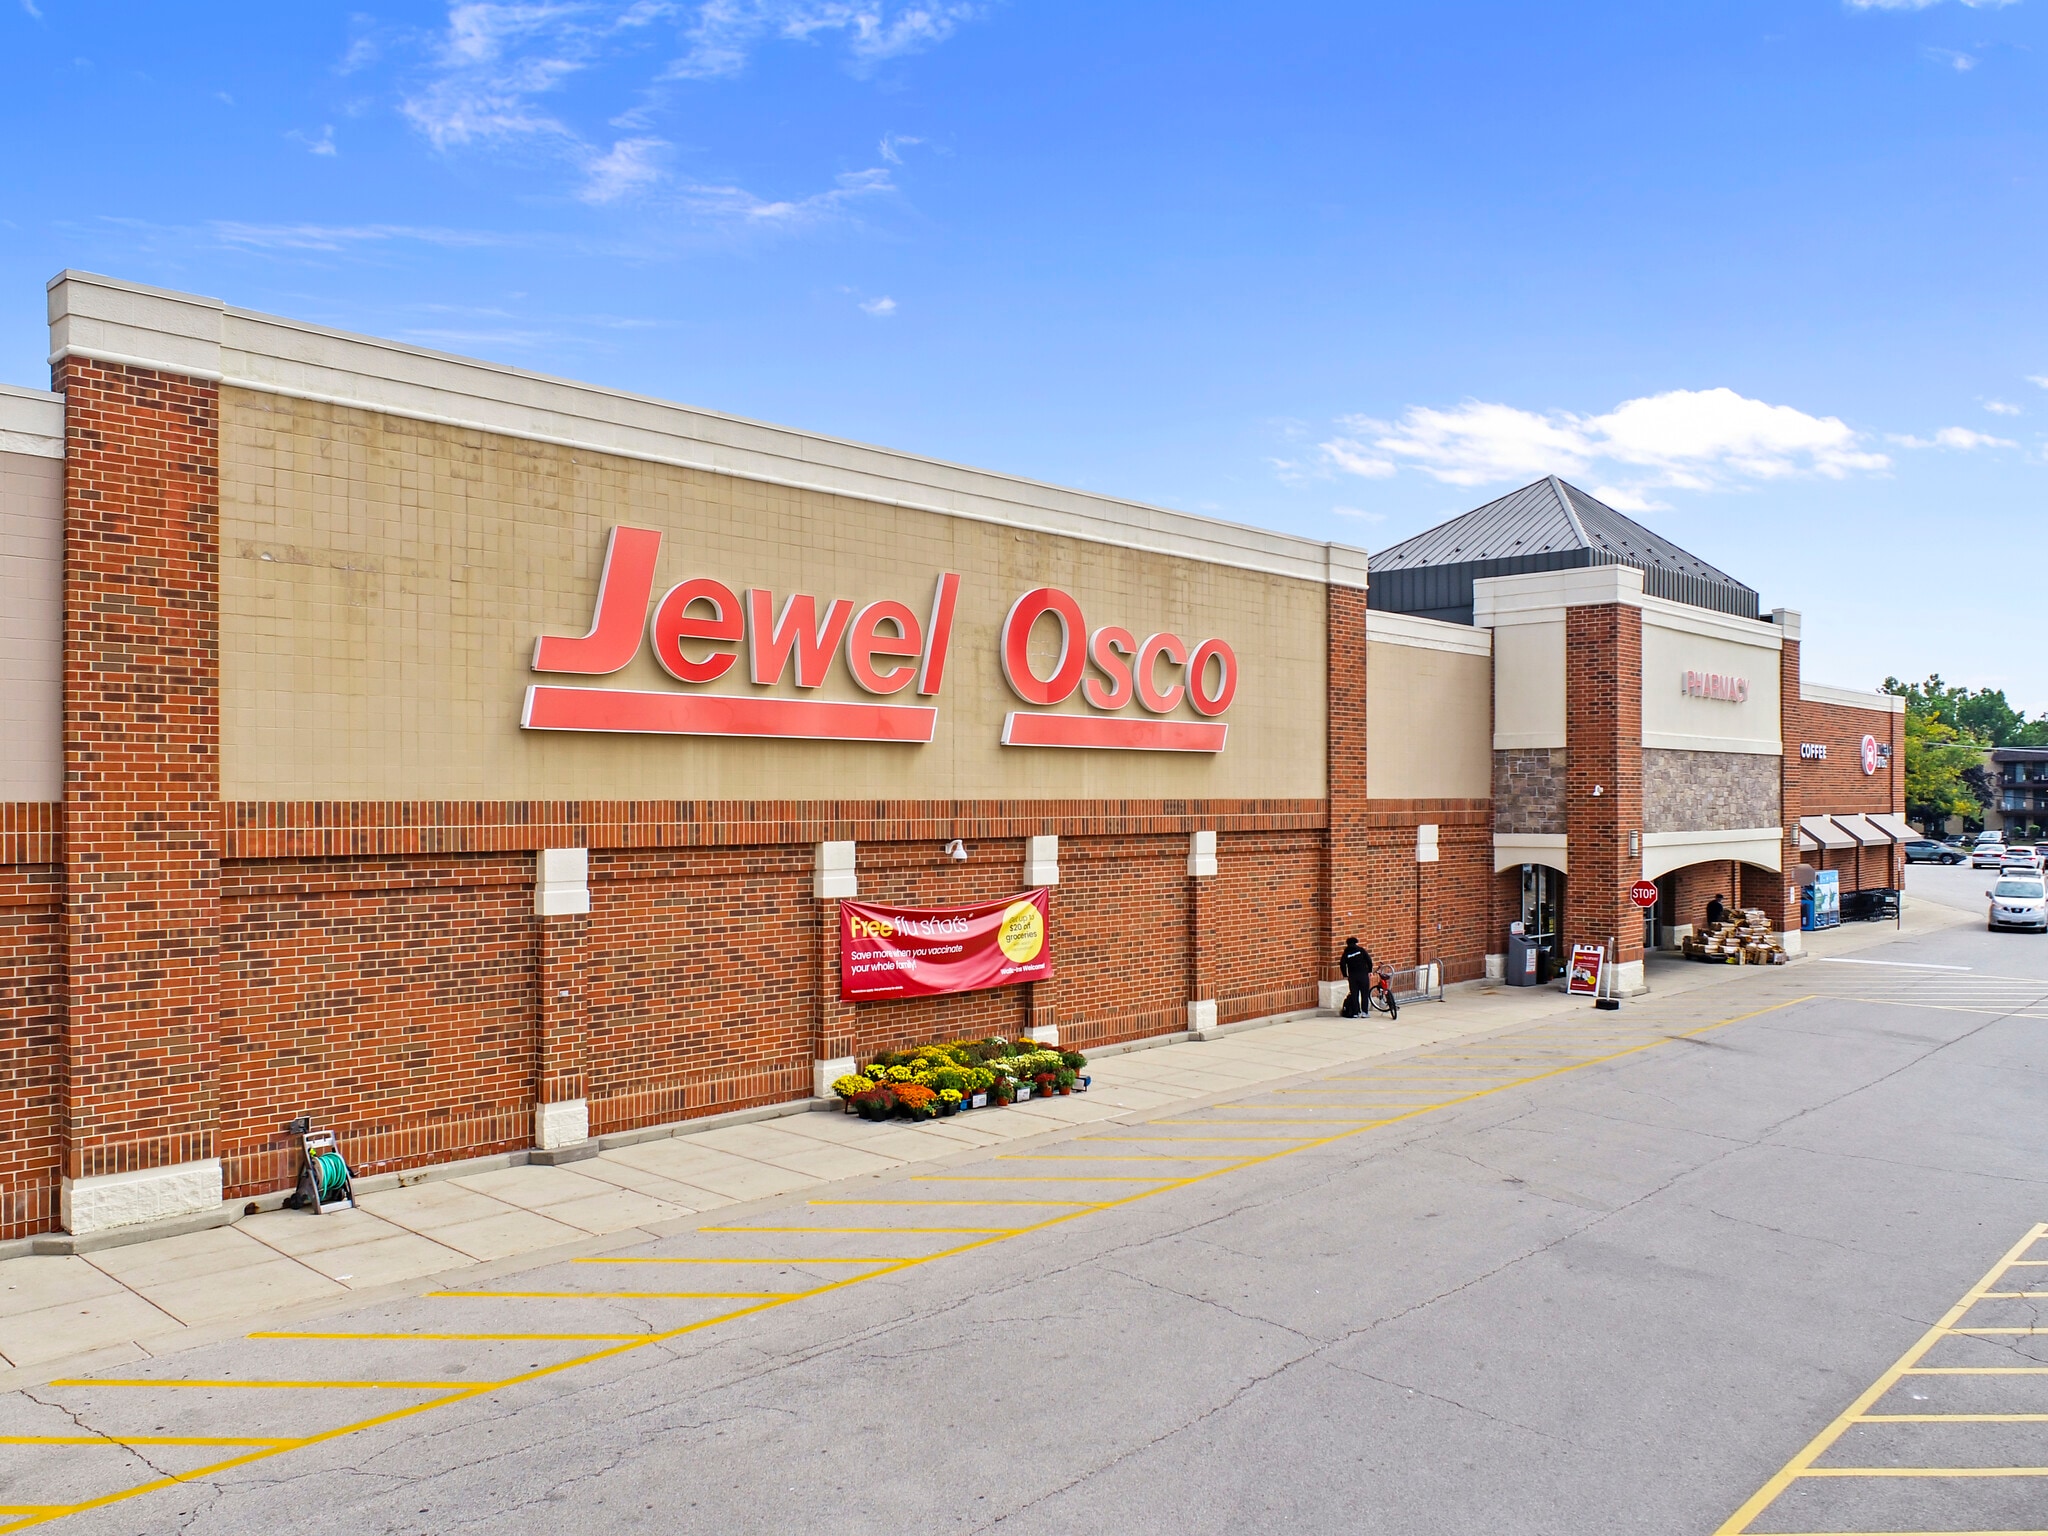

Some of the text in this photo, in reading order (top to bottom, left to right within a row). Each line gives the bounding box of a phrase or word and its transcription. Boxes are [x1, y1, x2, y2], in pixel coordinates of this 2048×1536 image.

[530, 525, 1239, 717] Jewel Osco
[1681, 671, 1750, 703] PHARMACY
[1800, 743, 1827, 760] COFFEE
[1632, 888, 1656, 899] STOP
[1010, 922, 1031, 931] $20 off
[1019, 915, 1028, 923] up
[851, 916, 894, 938] Free
[894, 916, 919, 936] flu
[1005, 931, 1037, 943] groceries
[851, 951, 872, 960] Save
[912, 948, 927, 958] you
[928, 945, 963, 955] vaccinate
[851, 964, 869, 976] your
[871, 961, 895, 972] whole
